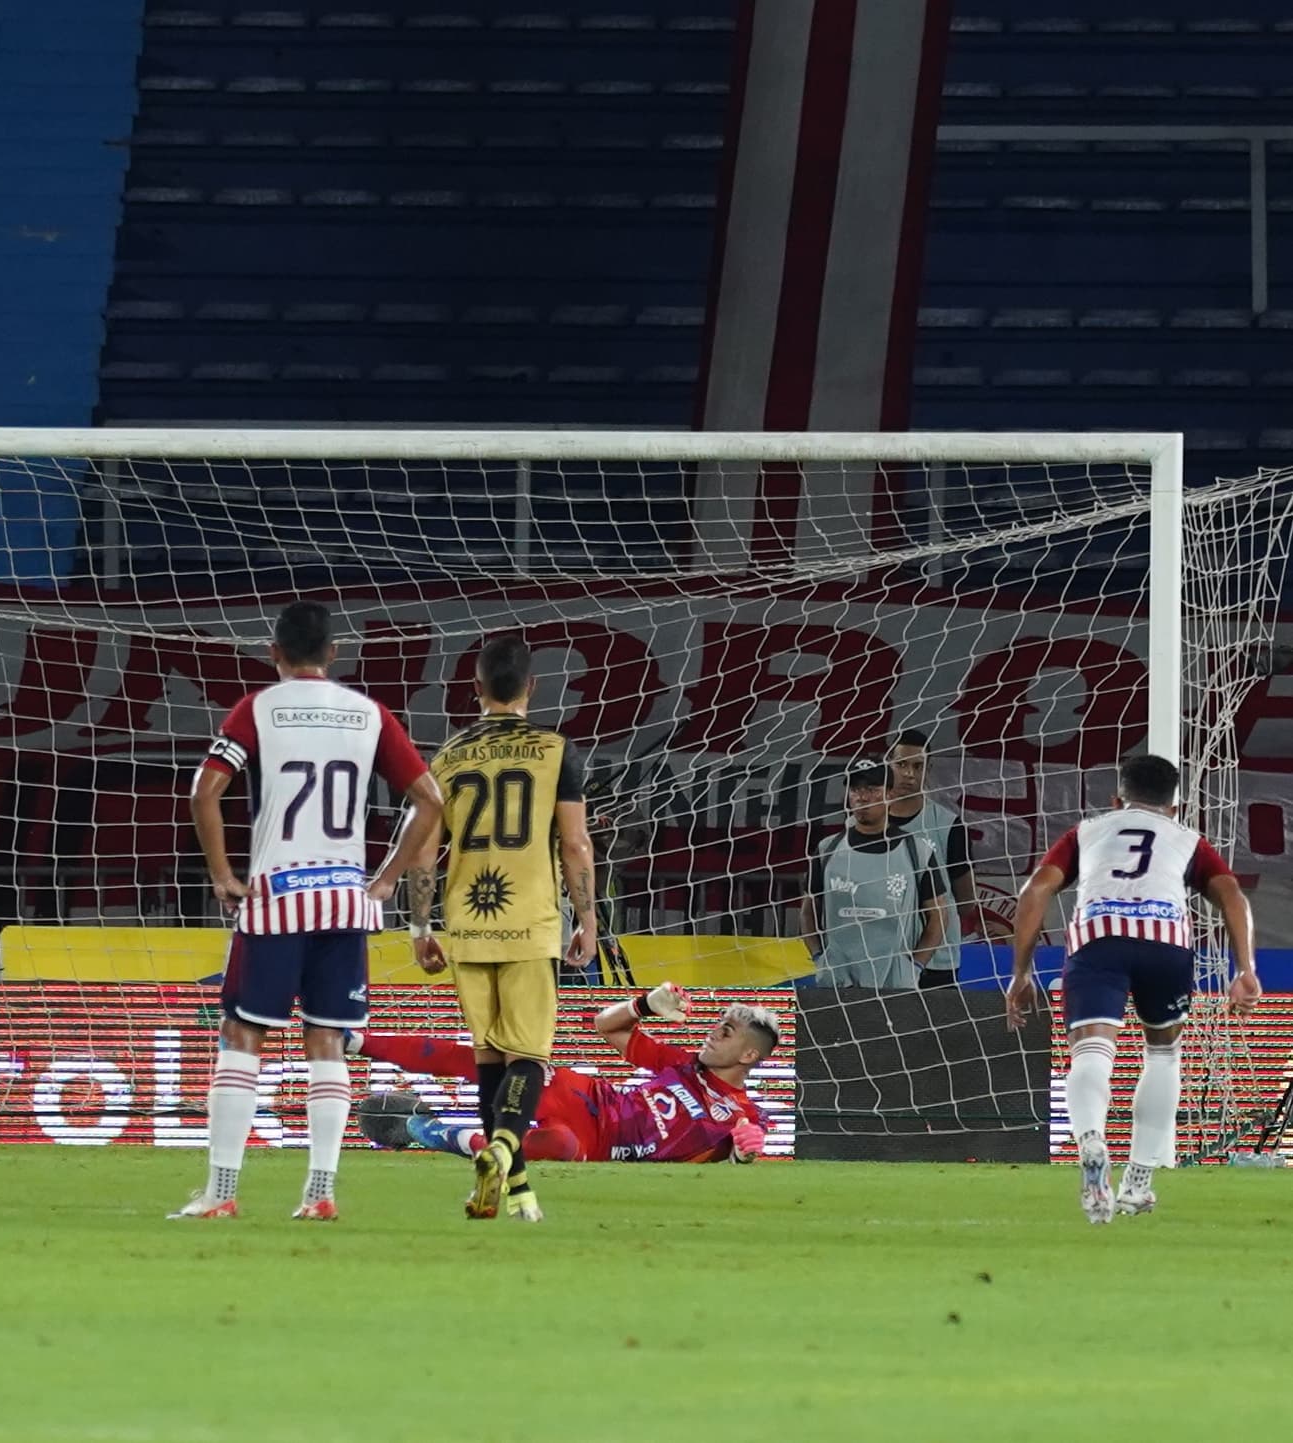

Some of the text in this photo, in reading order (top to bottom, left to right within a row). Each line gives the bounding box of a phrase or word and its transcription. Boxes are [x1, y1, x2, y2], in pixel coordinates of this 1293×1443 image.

[276, 712, 364, 725] BLACK+DECKER
[490, 745, 546, 761] DORADAS
[281, 760, 359, 841] 70
[449, 768, 535, 853] 20
[1112, 828, 1156, 880] 3
[463, 928, 531, 941] aerosport
